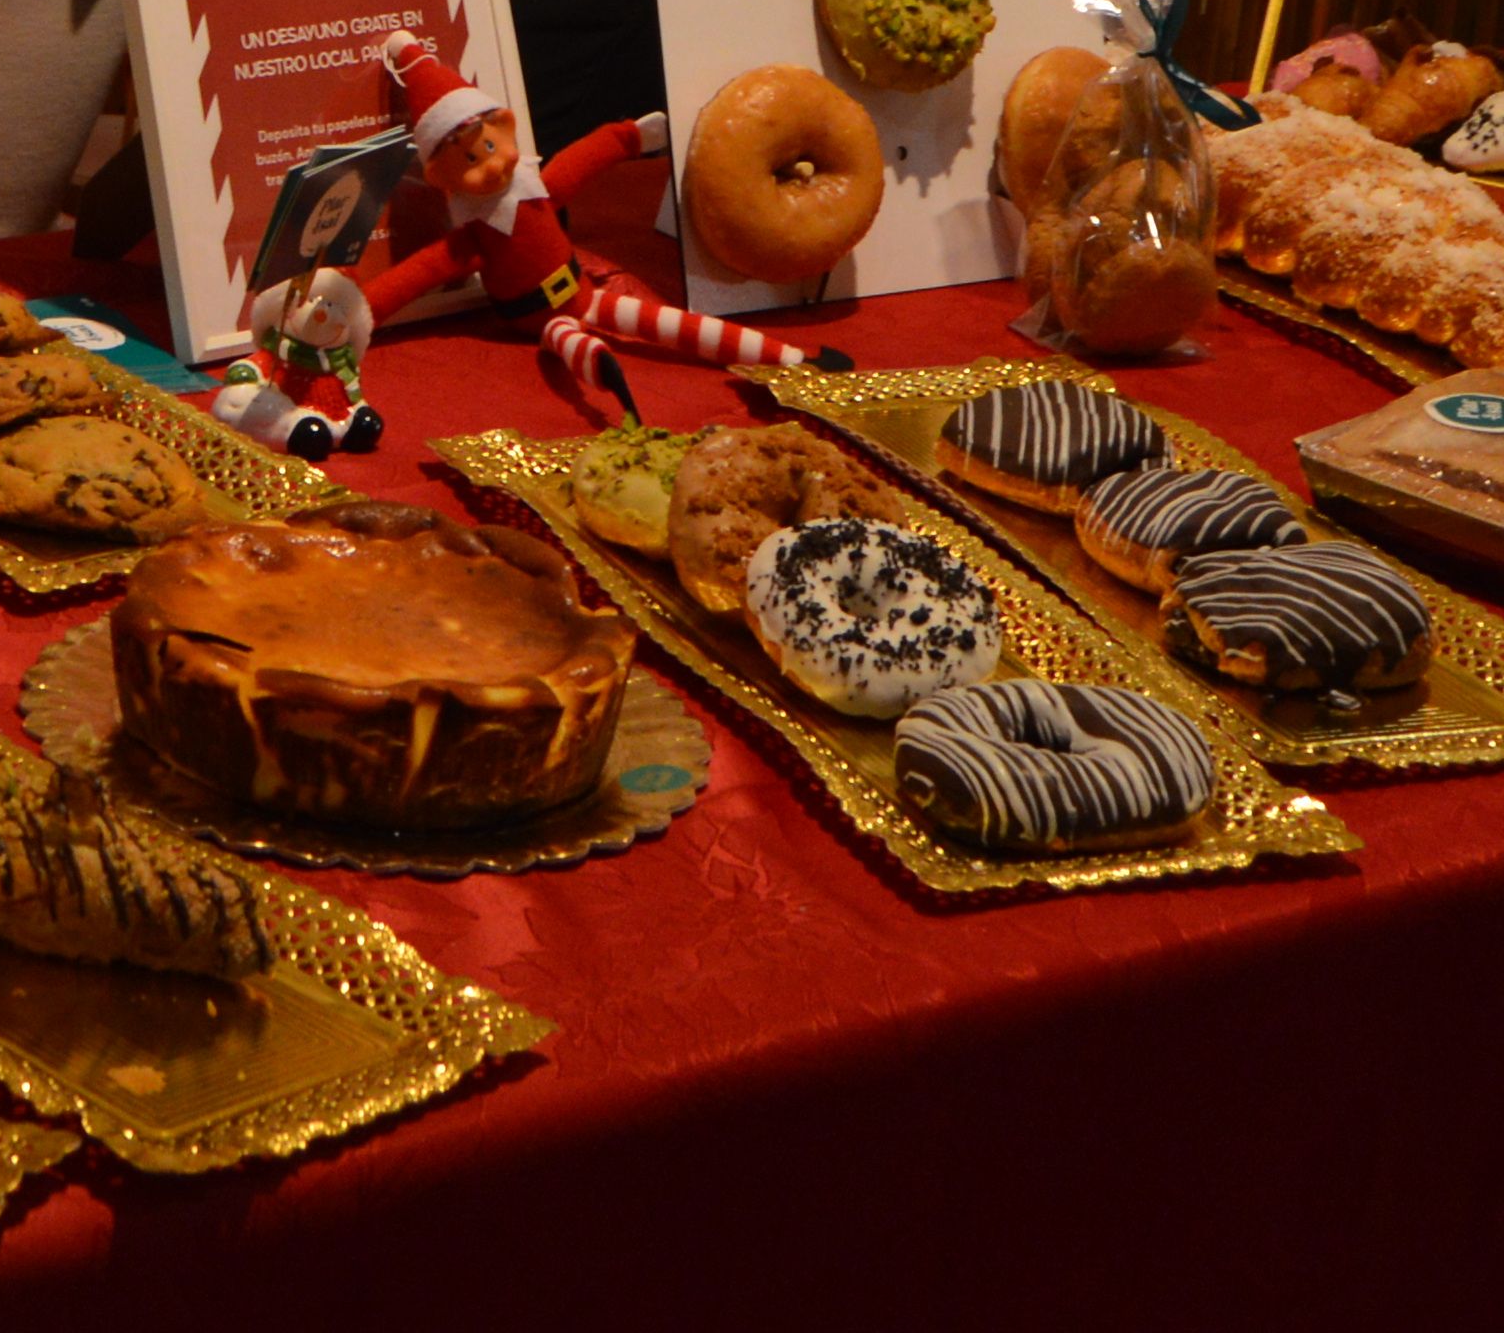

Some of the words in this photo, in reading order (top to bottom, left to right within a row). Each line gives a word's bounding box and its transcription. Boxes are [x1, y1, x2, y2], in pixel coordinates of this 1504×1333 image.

[240, 31, 265, 50] UN
[266, 19, 349, 47] DESAYUNO
[350, 12, 401, 35] GRATIS
[402, 9, 425, 27] EN
[234, 54, 308, 81] NUESTRO
[310, 47, 360, 70] LOCAL
[257, 124, 312, 144] Deposita
[312, 122, 326, 135] tu
